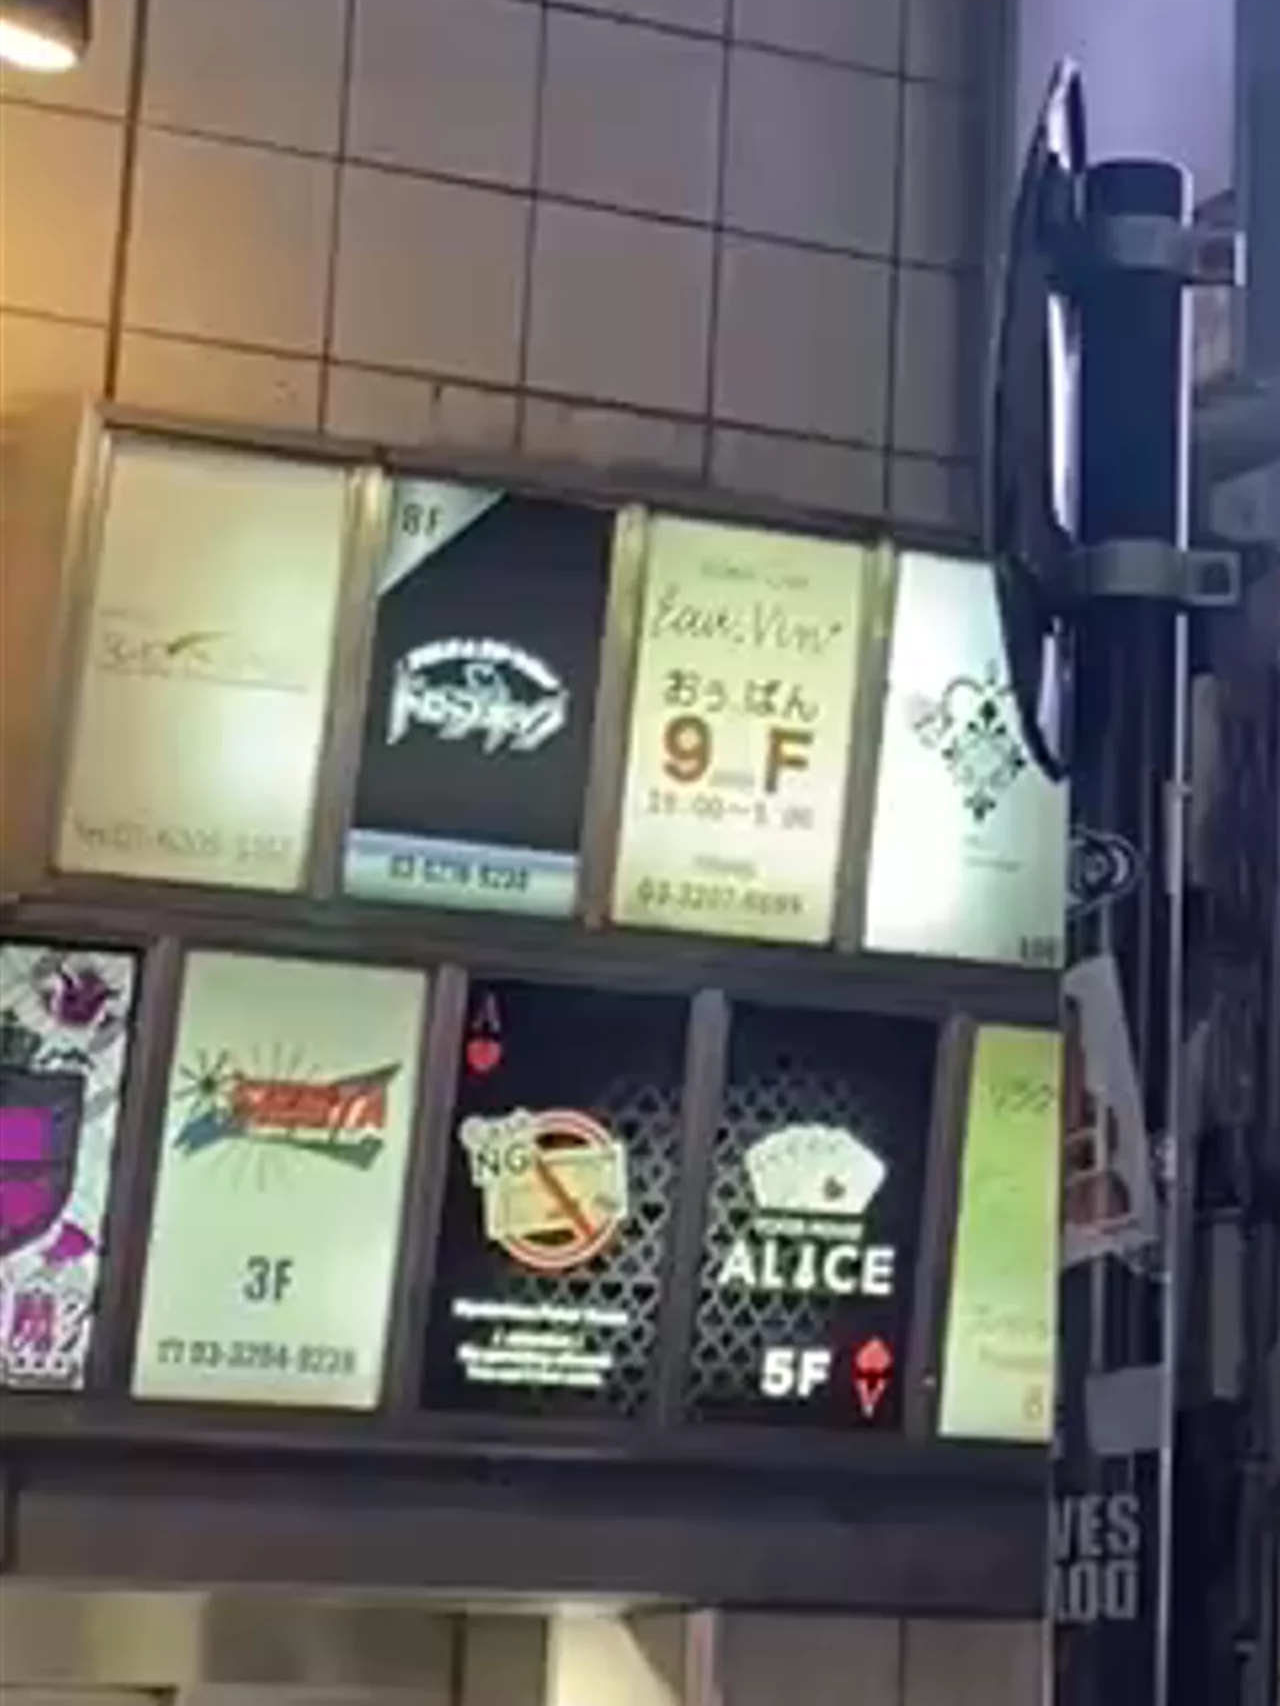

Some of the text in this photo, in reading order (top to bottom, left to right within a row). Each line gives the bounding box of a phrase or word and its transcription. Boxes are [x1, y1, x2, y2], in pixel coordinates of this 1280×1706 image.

[402, 503, 444, 538] 8F
[242, 1255, 294, 1302] 3F
[718, 1238, 896, 1297] ALICE
[760, 1348, 832, 1399] 5F
